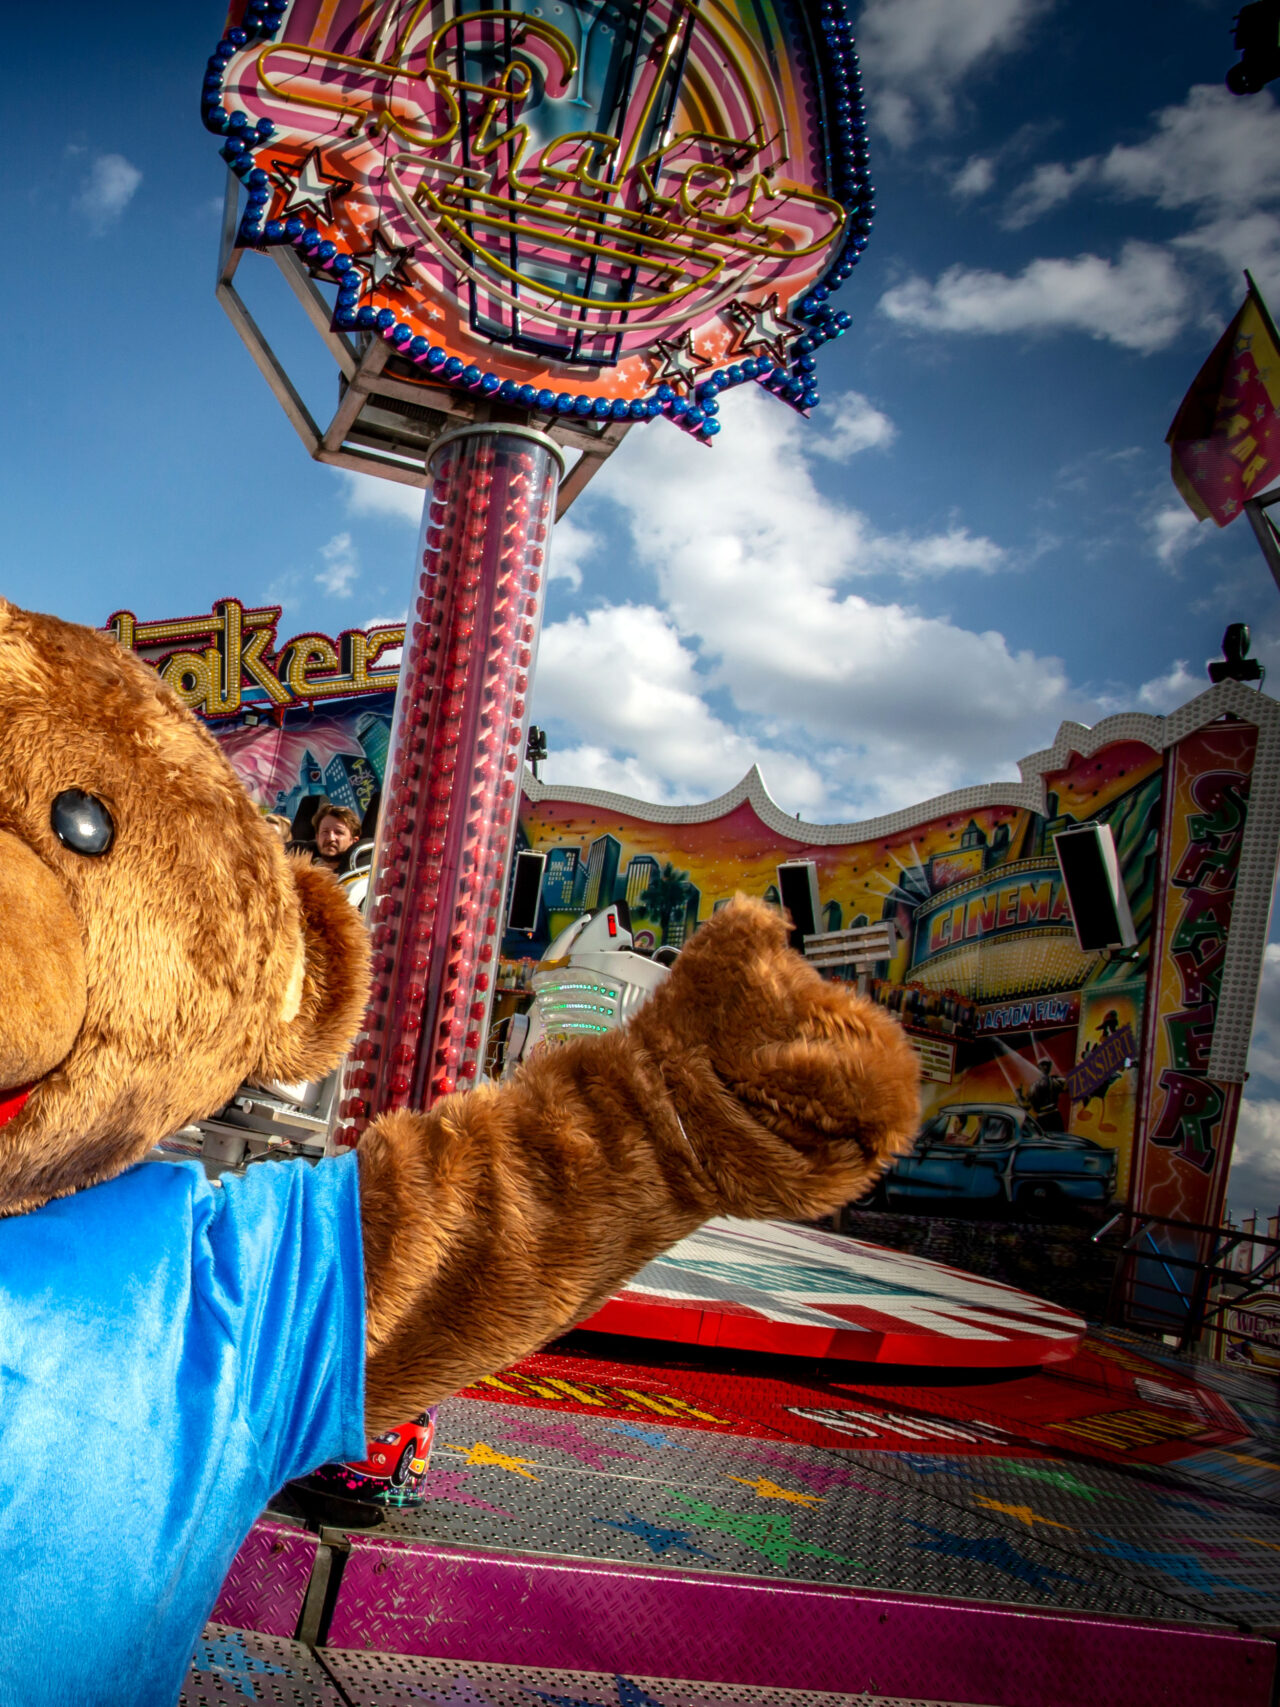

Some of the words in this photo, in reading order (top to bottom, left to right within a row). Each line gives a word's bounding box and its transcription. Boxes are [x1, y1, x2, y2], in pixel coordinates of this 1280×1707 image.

[111, 597, 406, 716] aker
[930, 880, 1072, 951] CINEMA
[983, 1003, 1032, 1029] ACTION
[1035, 999, 1070, 1023] FILM
[1070, 1028, 1135, 1097] ZENSIERT
